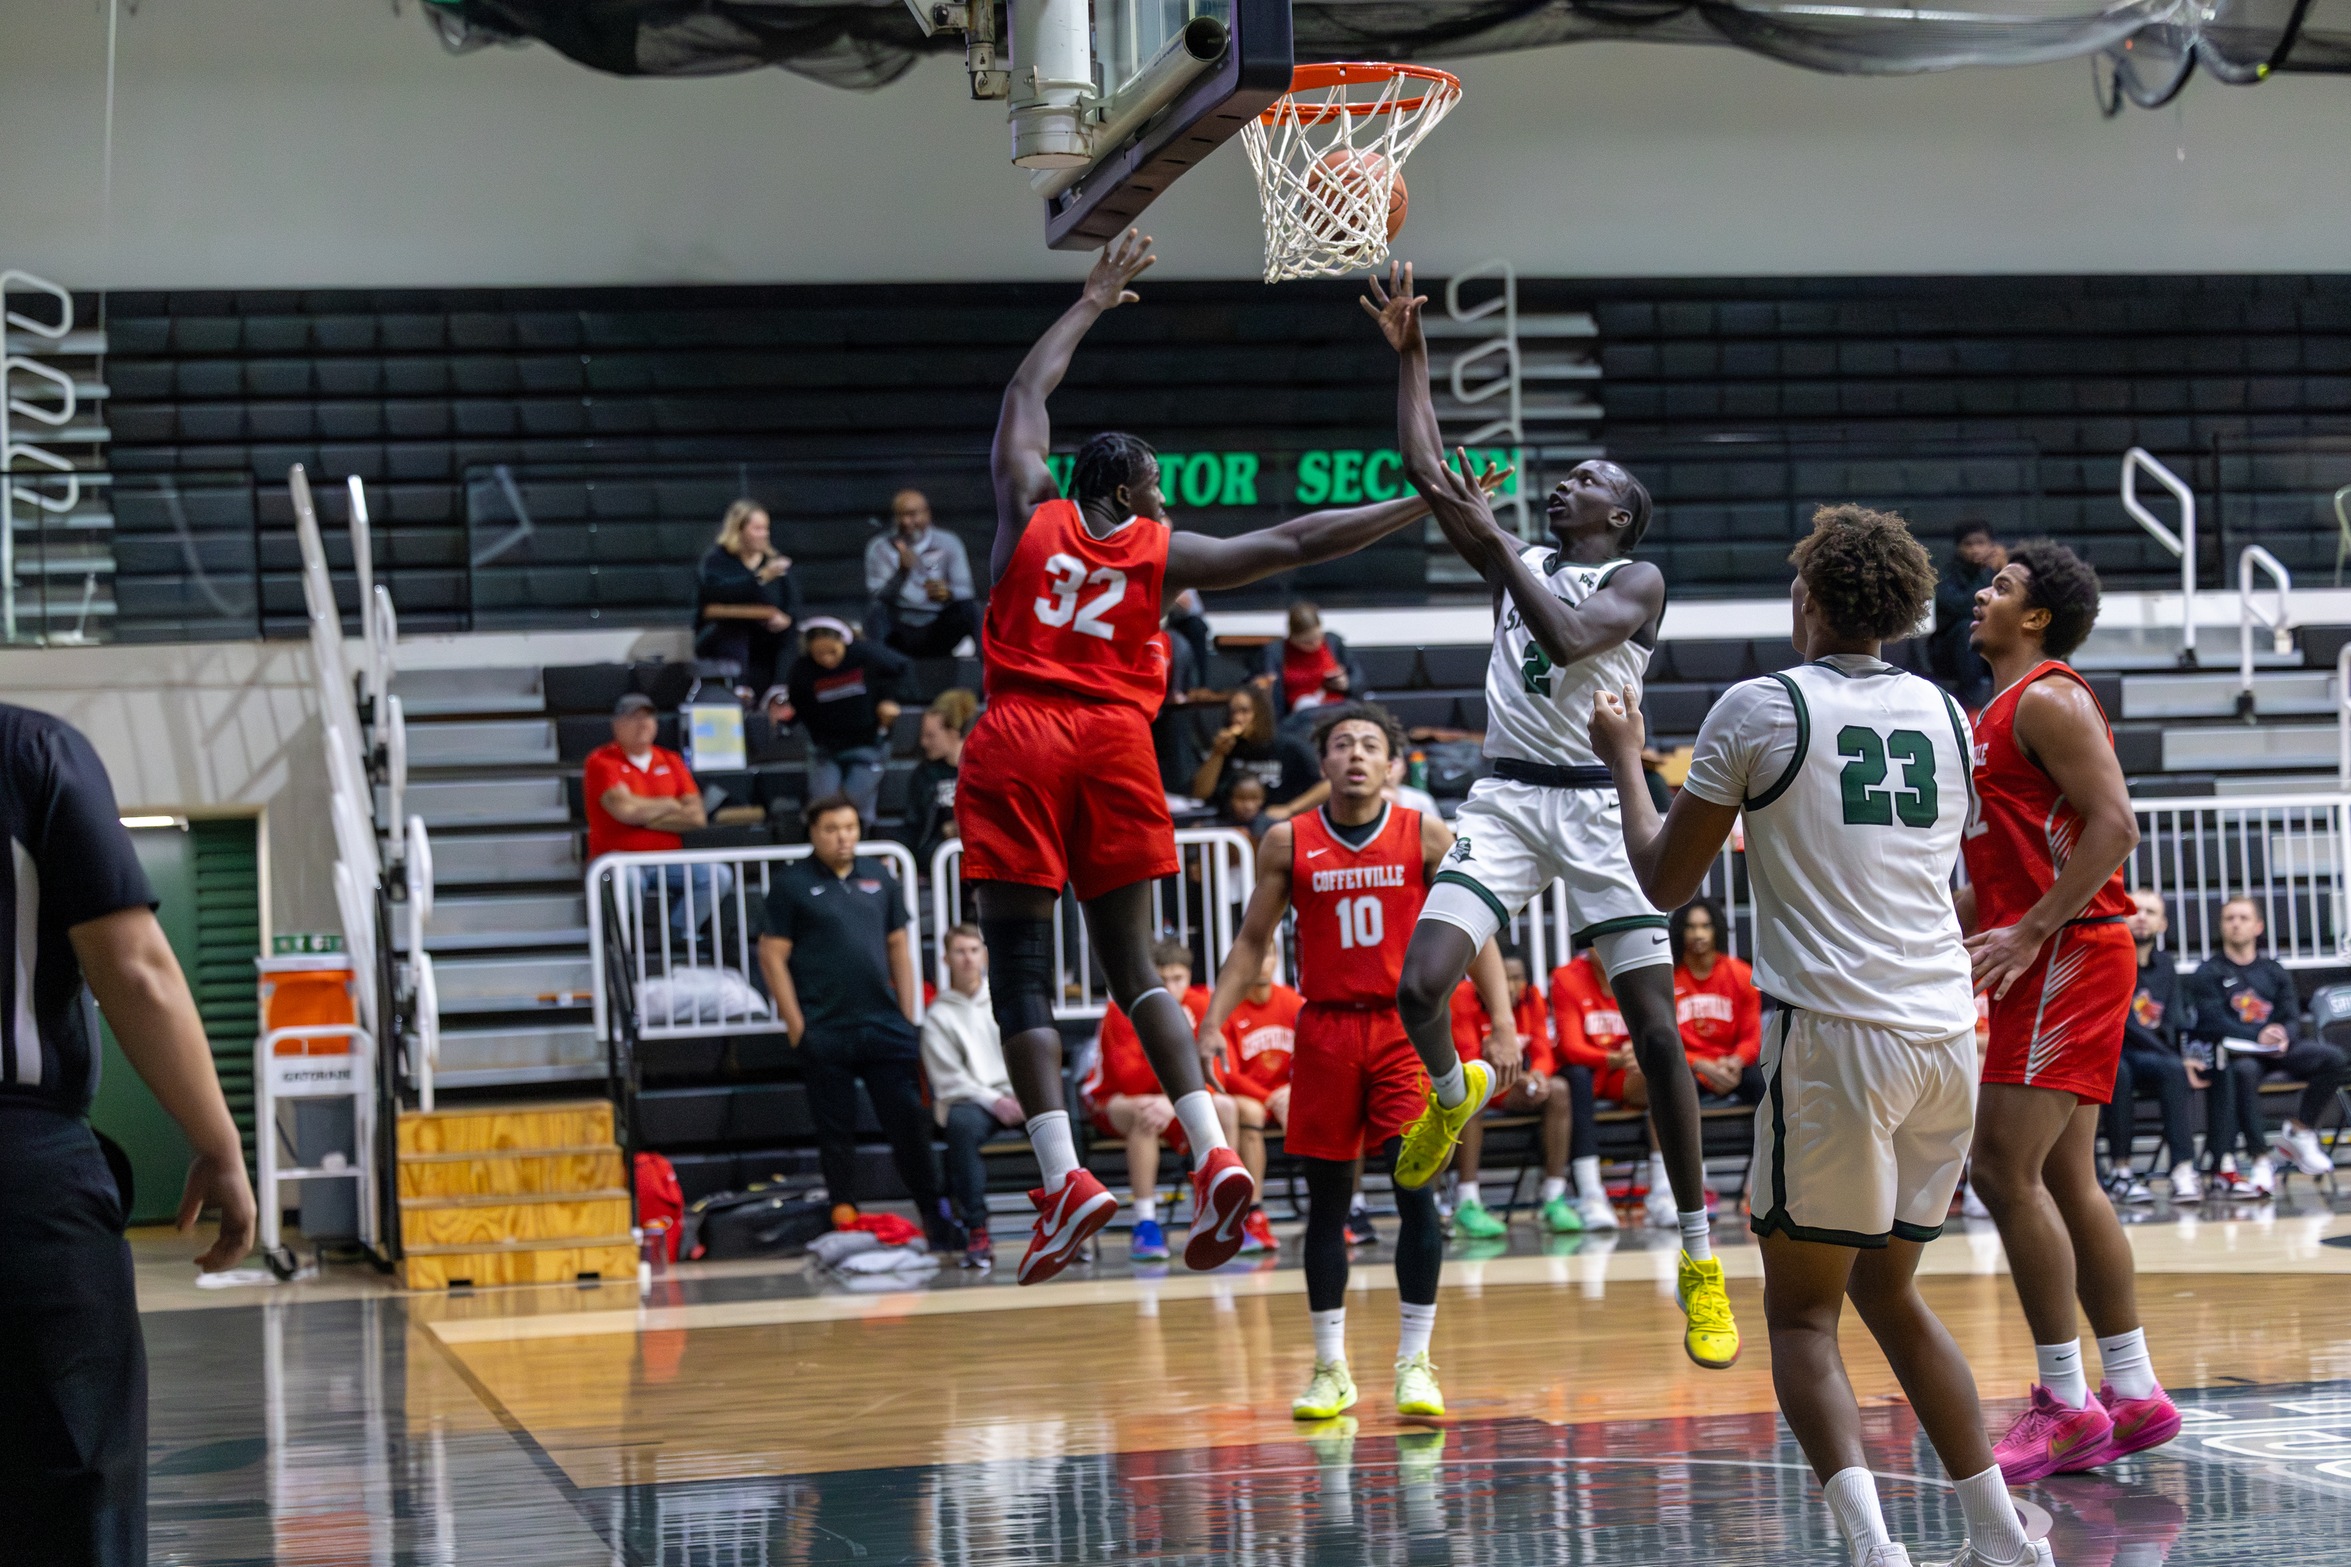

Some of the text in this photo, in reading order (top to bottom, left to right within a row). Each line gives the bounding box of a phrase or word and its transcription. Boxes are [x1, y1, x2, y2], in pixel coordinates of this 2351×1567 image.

[1033, 552, 1127, 641] 32
[1522, 640, 1551, 698] 2
[1837, 725, 1939, 828] 23
[1312, 864, 1405, 893] COFFEYVILLE
[1335, 894, 1385, 950] 10
